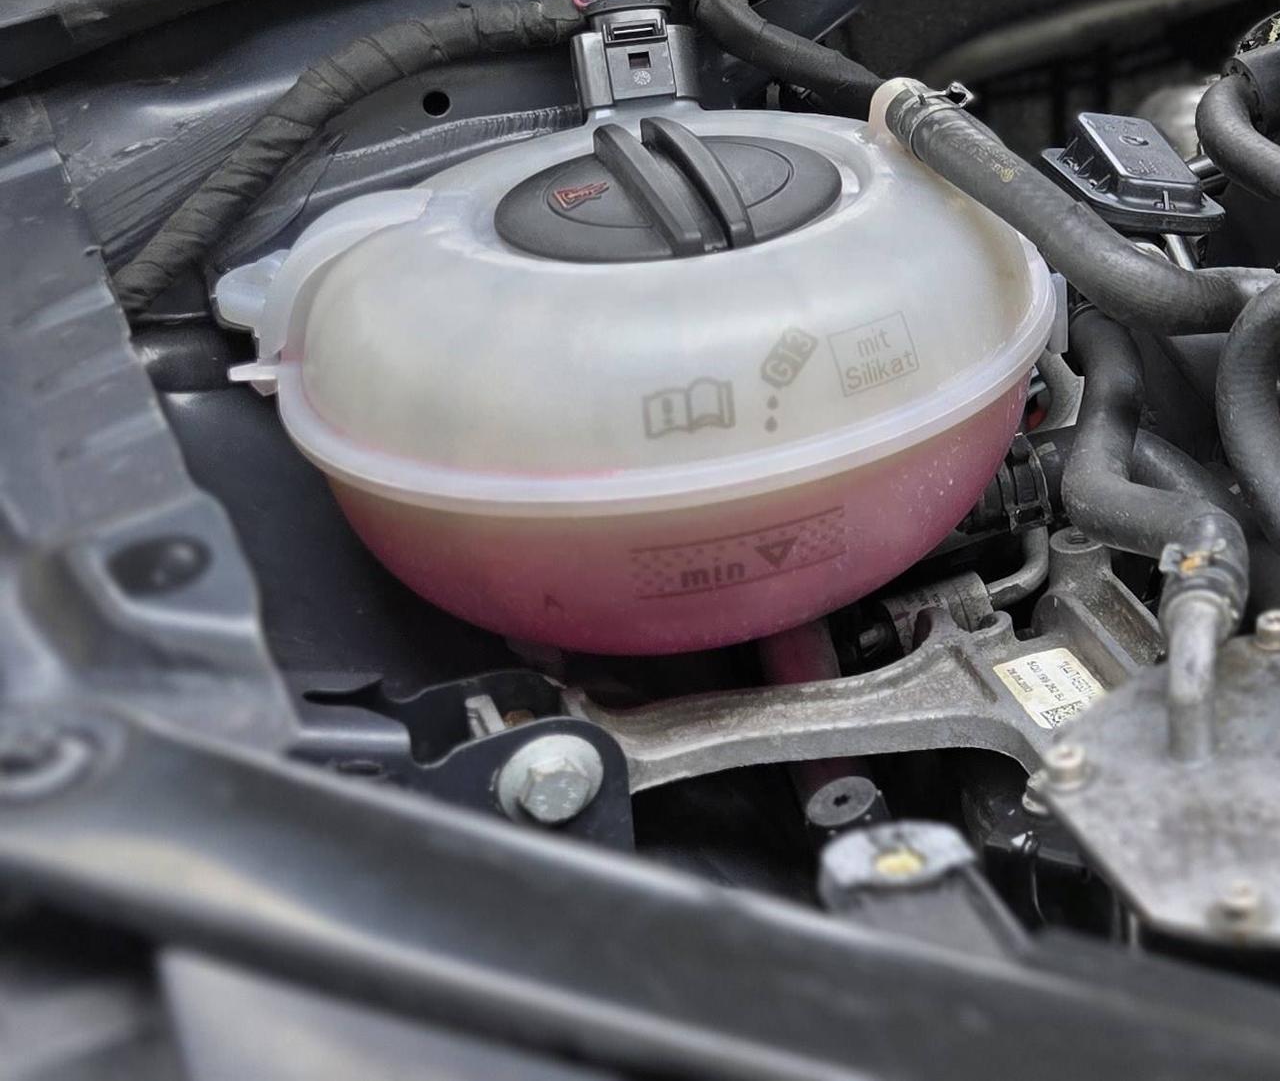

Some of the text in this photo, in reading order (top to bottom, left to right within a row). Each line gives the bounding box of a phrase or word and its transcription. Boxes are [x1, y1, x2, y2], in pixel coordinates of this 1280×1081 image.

[766, 332, 812, 381] G13
[857, 328, 890, 356] mit
[846, 350, 914, 389] Silikat
[681, 559, 745, 587] min
